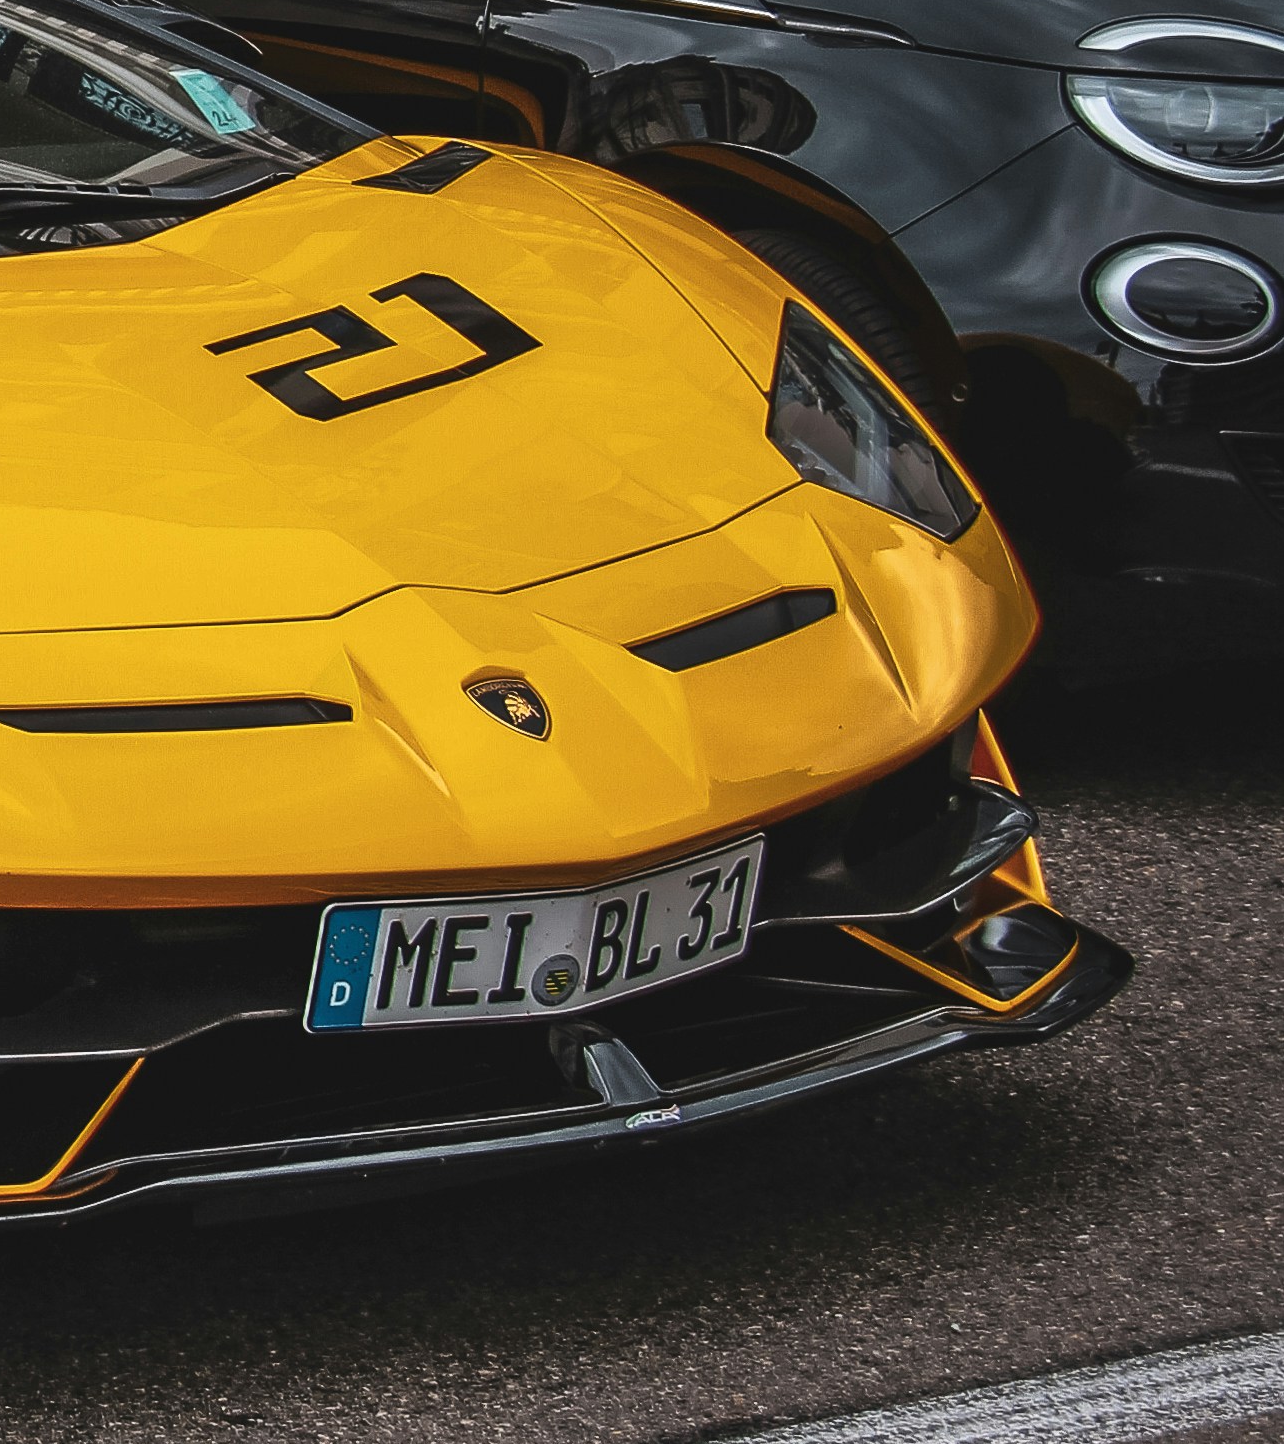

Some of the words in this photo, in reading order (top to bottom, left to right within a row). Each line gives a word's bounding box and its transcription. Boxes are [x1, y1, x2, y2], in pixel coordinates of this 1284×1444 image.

[376, 913, 532, 1010] MEI
[584, 890, 660, 992] BL
[677, 856, 751, 960] 31
[330, 982, 351, 1007] D
